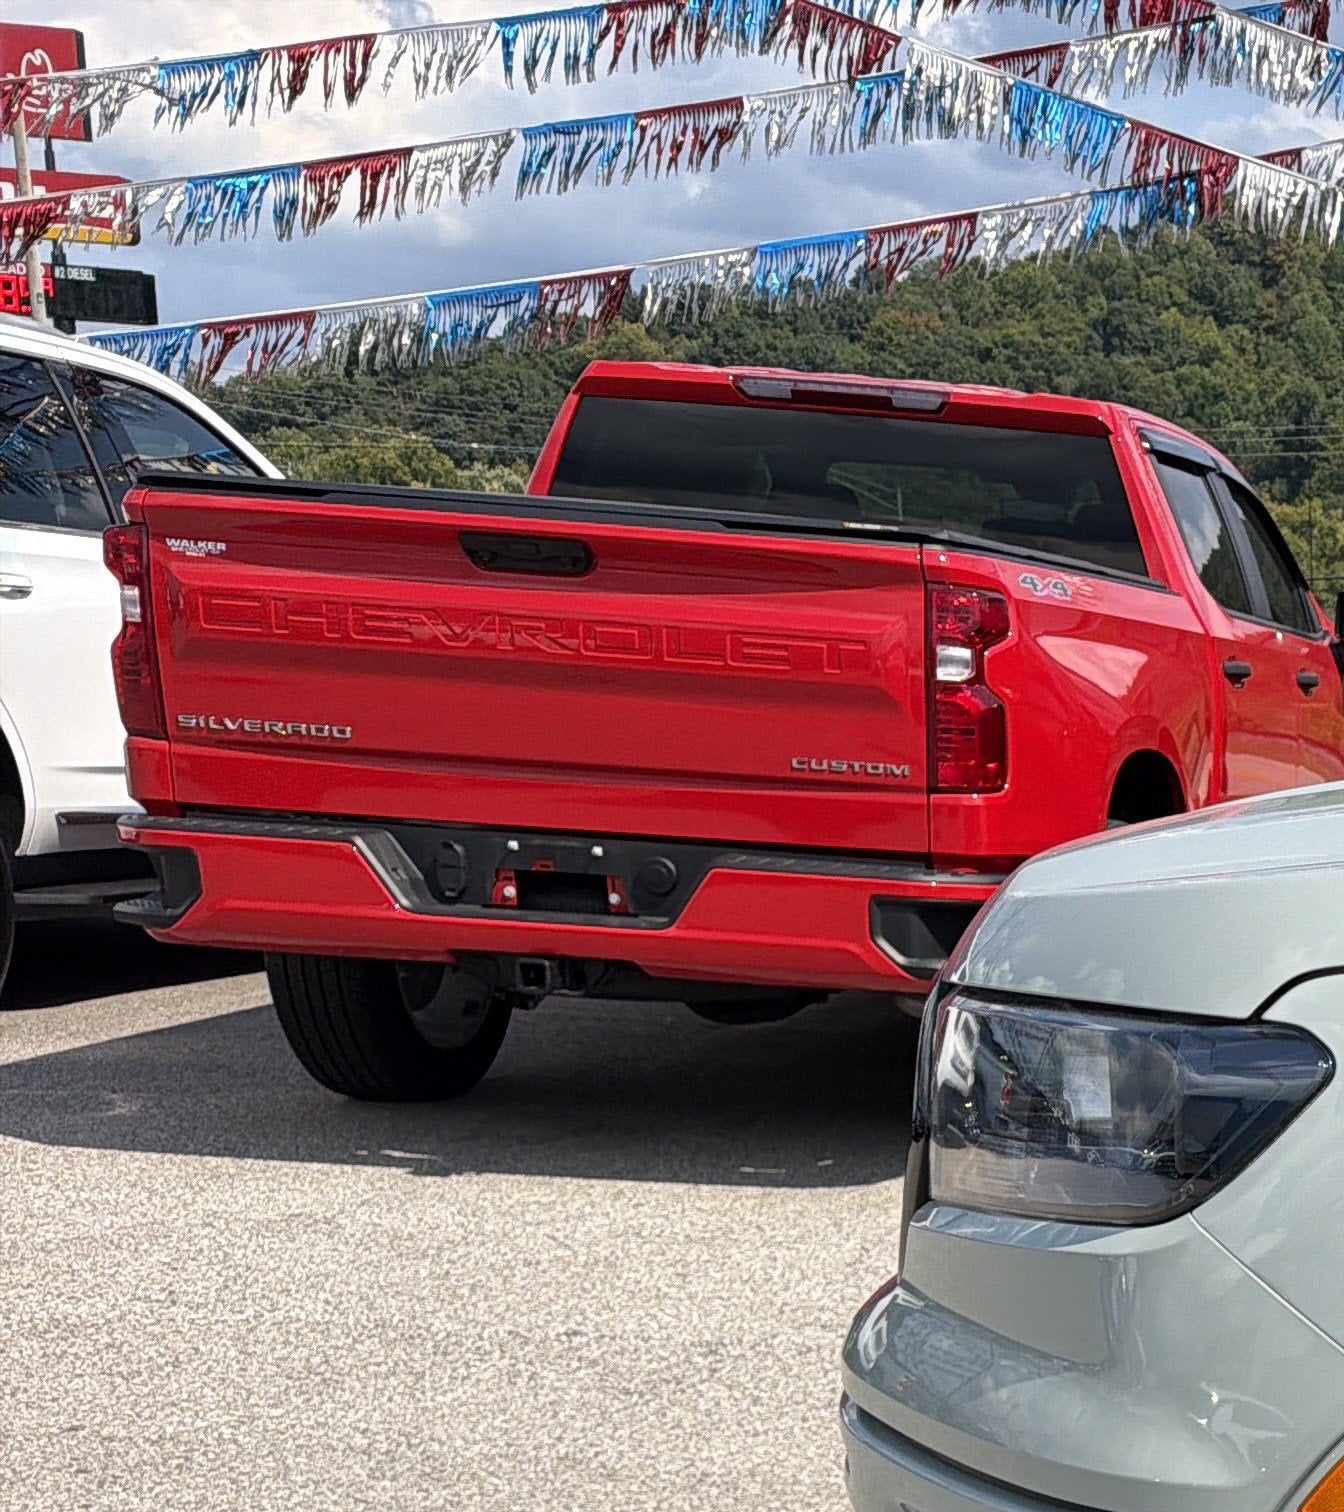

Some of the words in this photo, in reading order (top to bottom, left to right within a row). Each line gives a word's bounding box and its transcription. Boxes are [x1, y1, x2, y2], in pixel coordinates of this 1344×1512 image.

[67, 267, 97, 282] DIESEL
[165, 537, 227, 552] WALKER
[199, 595, 868, 675] CHEVROLET
[177, 714, 352, 740] SILVERADO
[791, 756, 910, 777] CUSTOM
